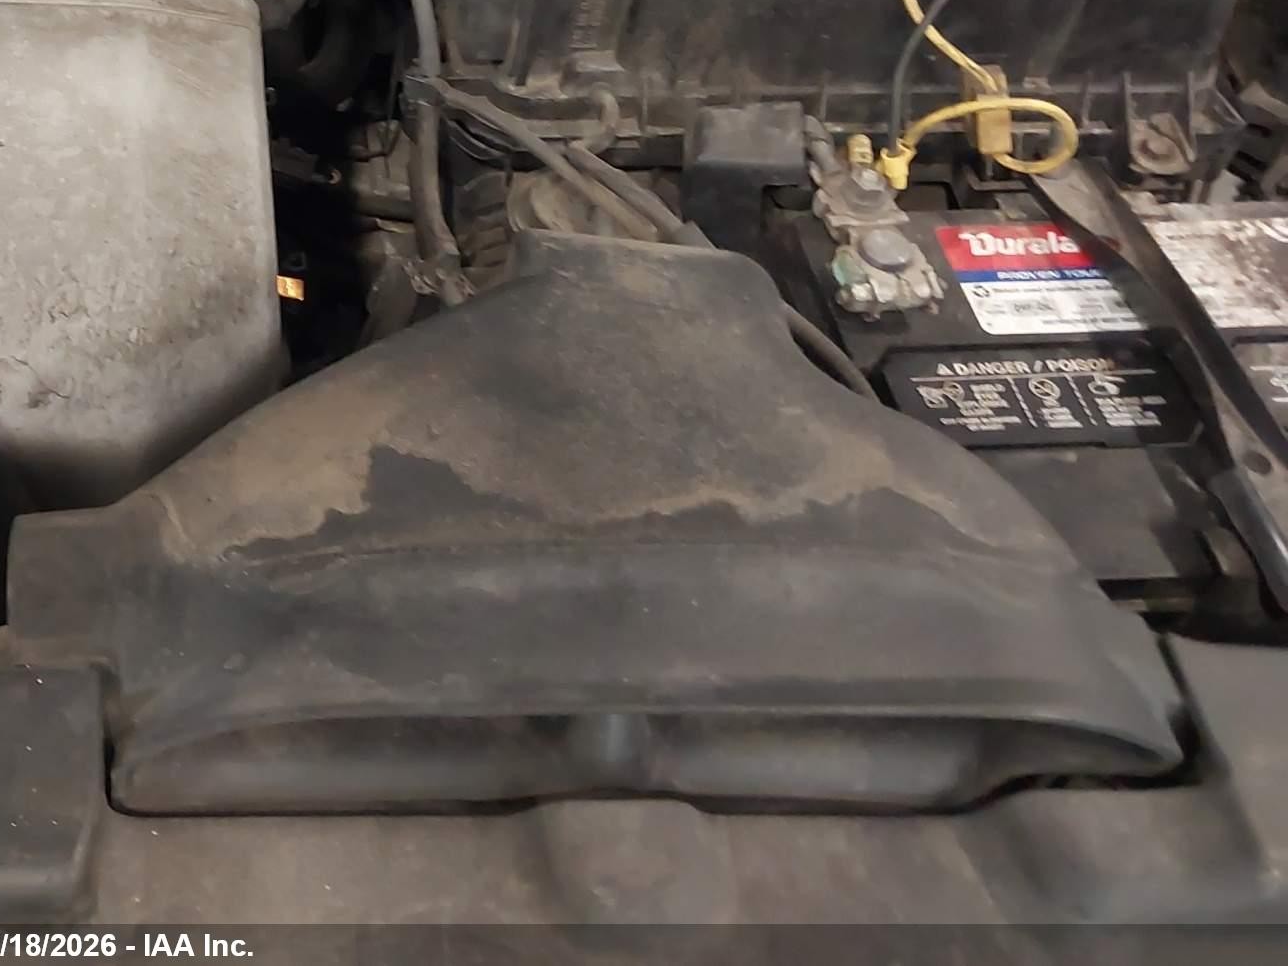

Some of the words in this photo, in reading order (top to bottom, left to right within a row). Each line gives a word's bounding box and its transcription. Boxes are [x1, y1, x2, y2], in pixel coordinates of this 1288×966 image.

[958, 231, 1080, 256] Durala
[953, 361, 1031, 375] DANGER
[1045, 358, 1116, 372] POISON
